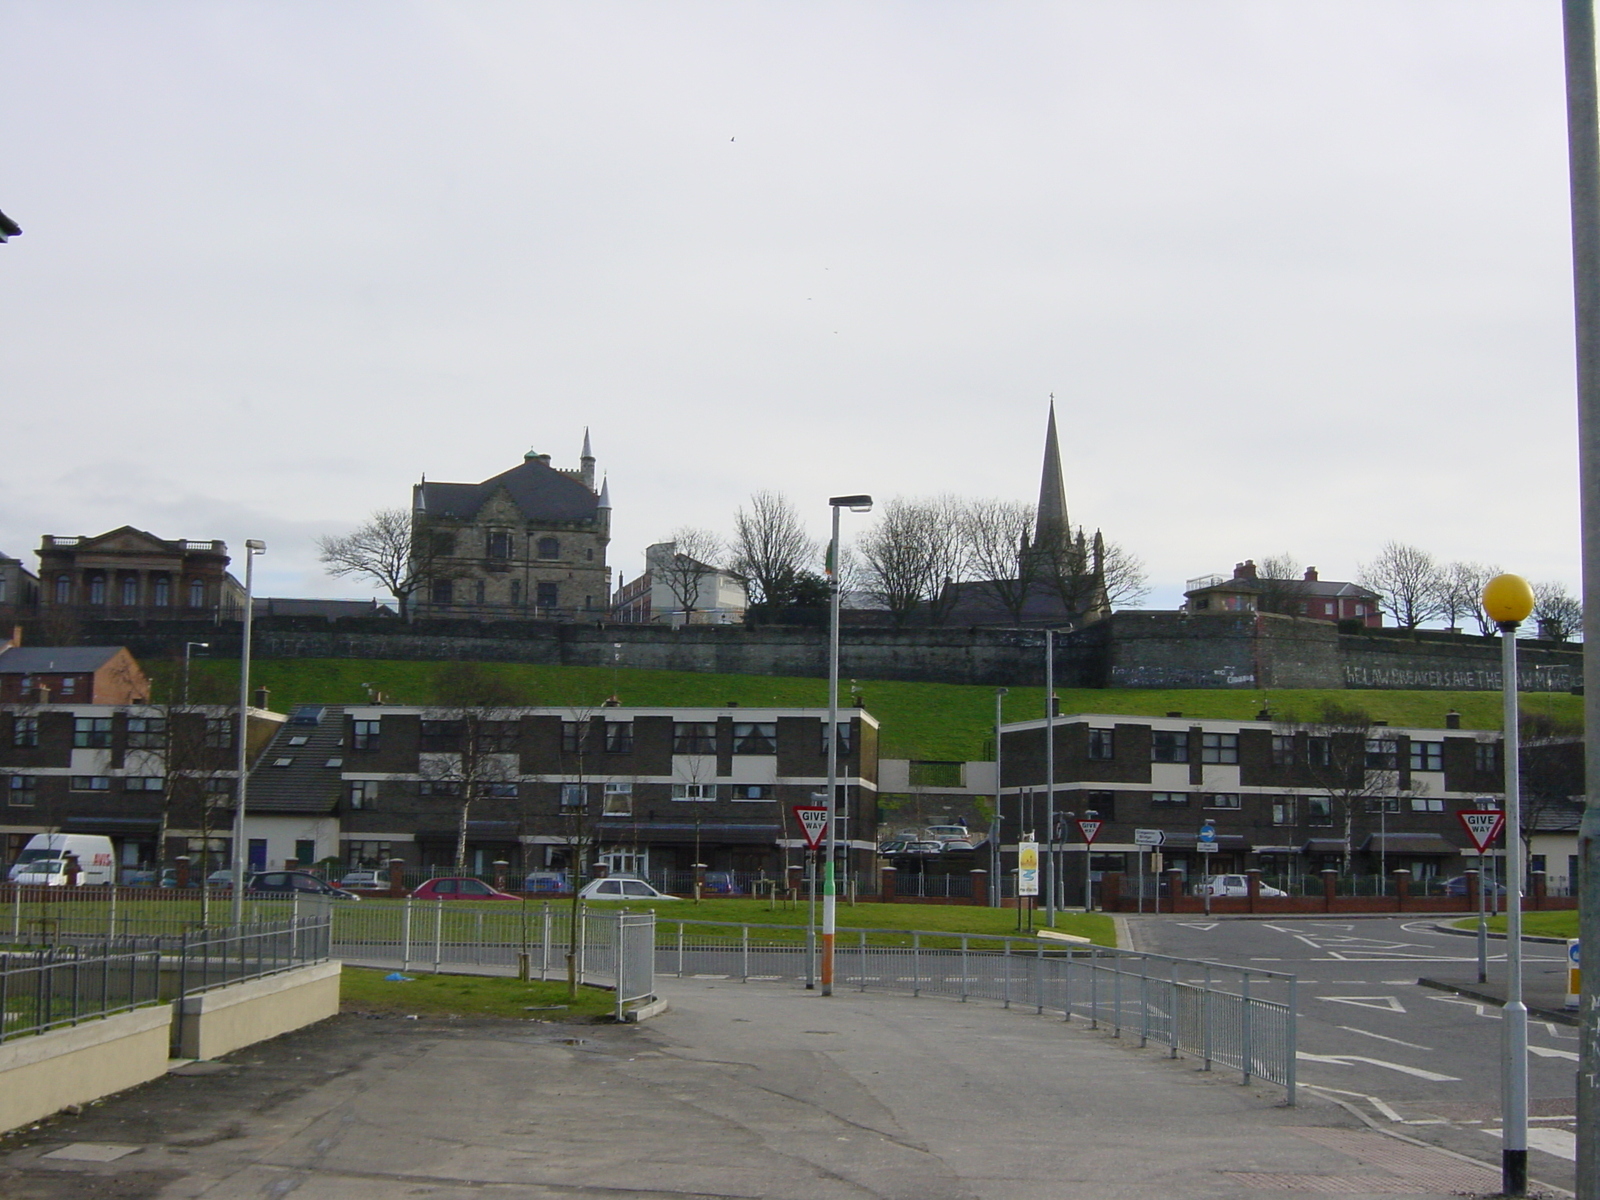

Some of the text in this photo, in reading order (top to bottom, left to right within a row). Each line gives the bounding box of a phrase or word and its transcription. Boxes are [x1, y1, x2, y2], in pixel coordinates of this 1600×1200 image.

[1472, 669, 1503, 689] THE
[802, 811, 826, 821] GIVE
[1468, 815, 1495, 825] GIVE
